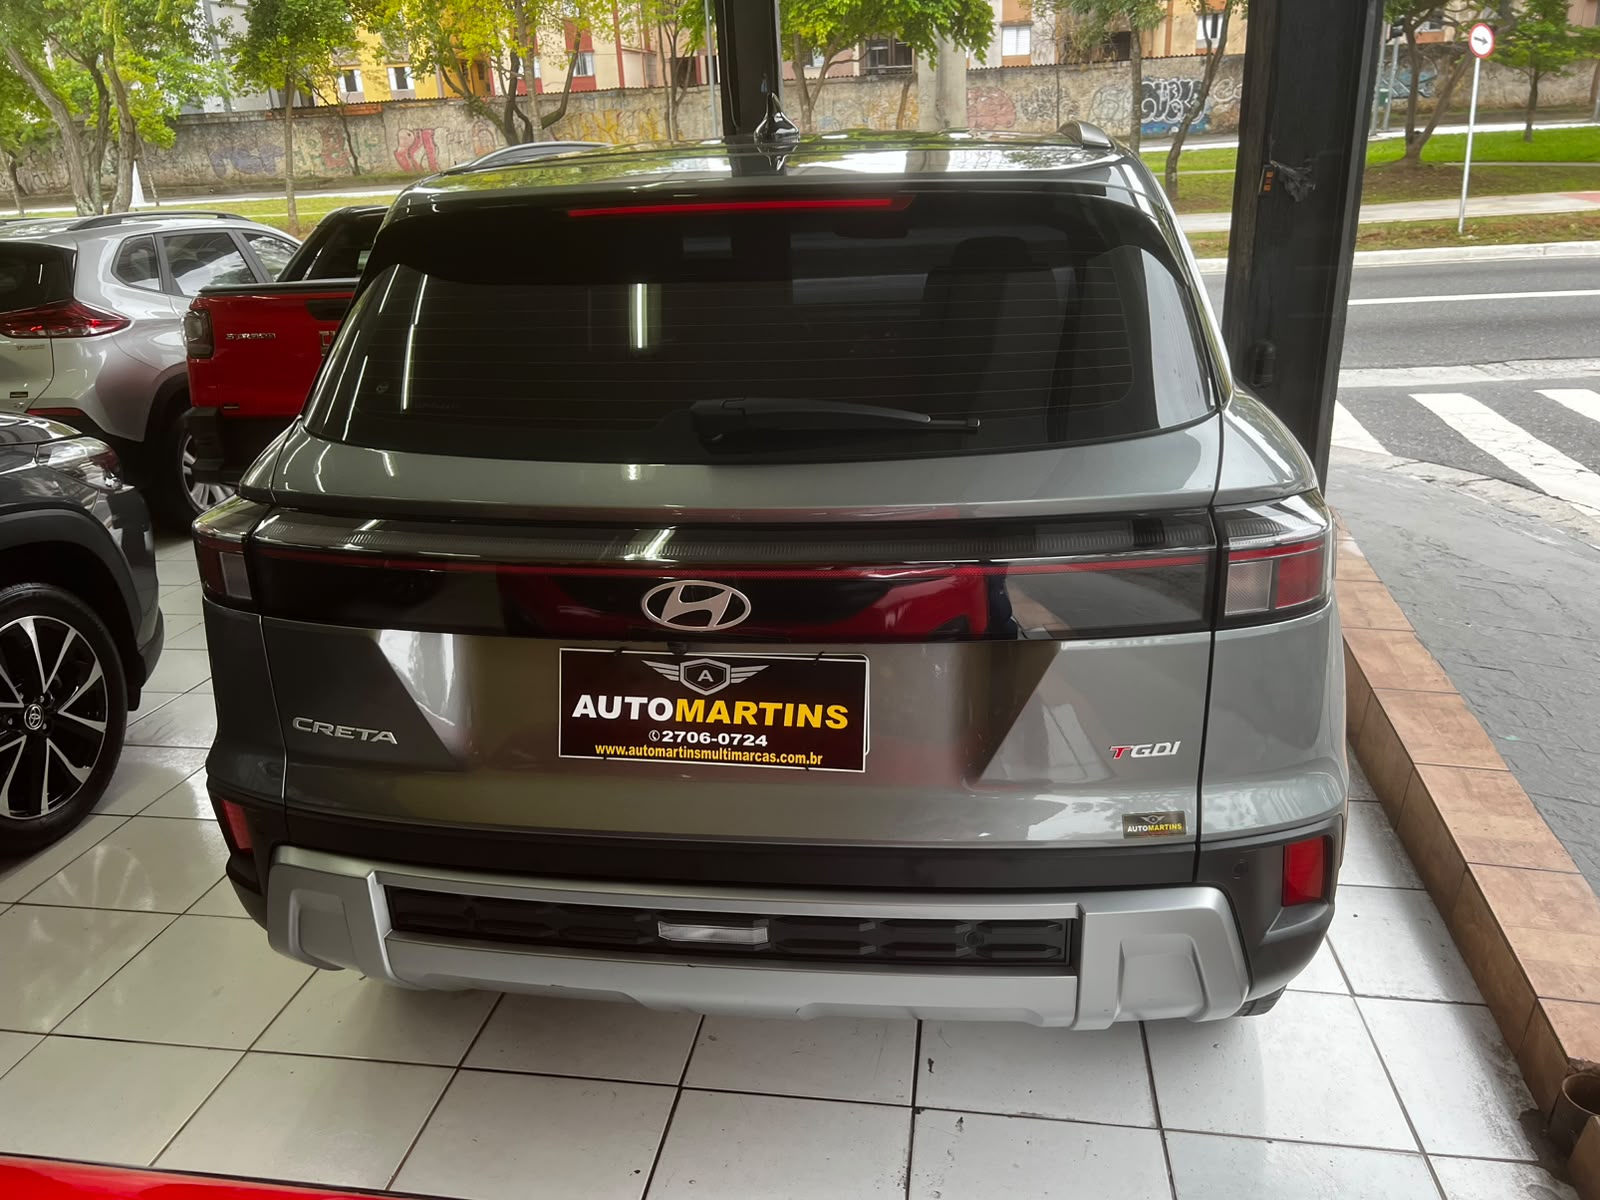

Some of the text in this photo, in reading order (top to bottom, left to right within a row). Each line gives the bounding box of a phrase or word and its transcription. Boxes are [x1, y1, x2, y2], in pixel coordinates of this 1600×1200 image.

[697, 670, 714, 682] A
[572, 695, 849, 729] AUTOMARTINS
[292, 716, 398, 745] CRETA
[662, 731, 767, 747] 2706-0724
[594, 743, 823, 765] www.automartinsmultimarcas.com.br
[1110, 740, 1181, 759] TGDI
[1127, 823, 1182, 832] AUTOMARTINS
